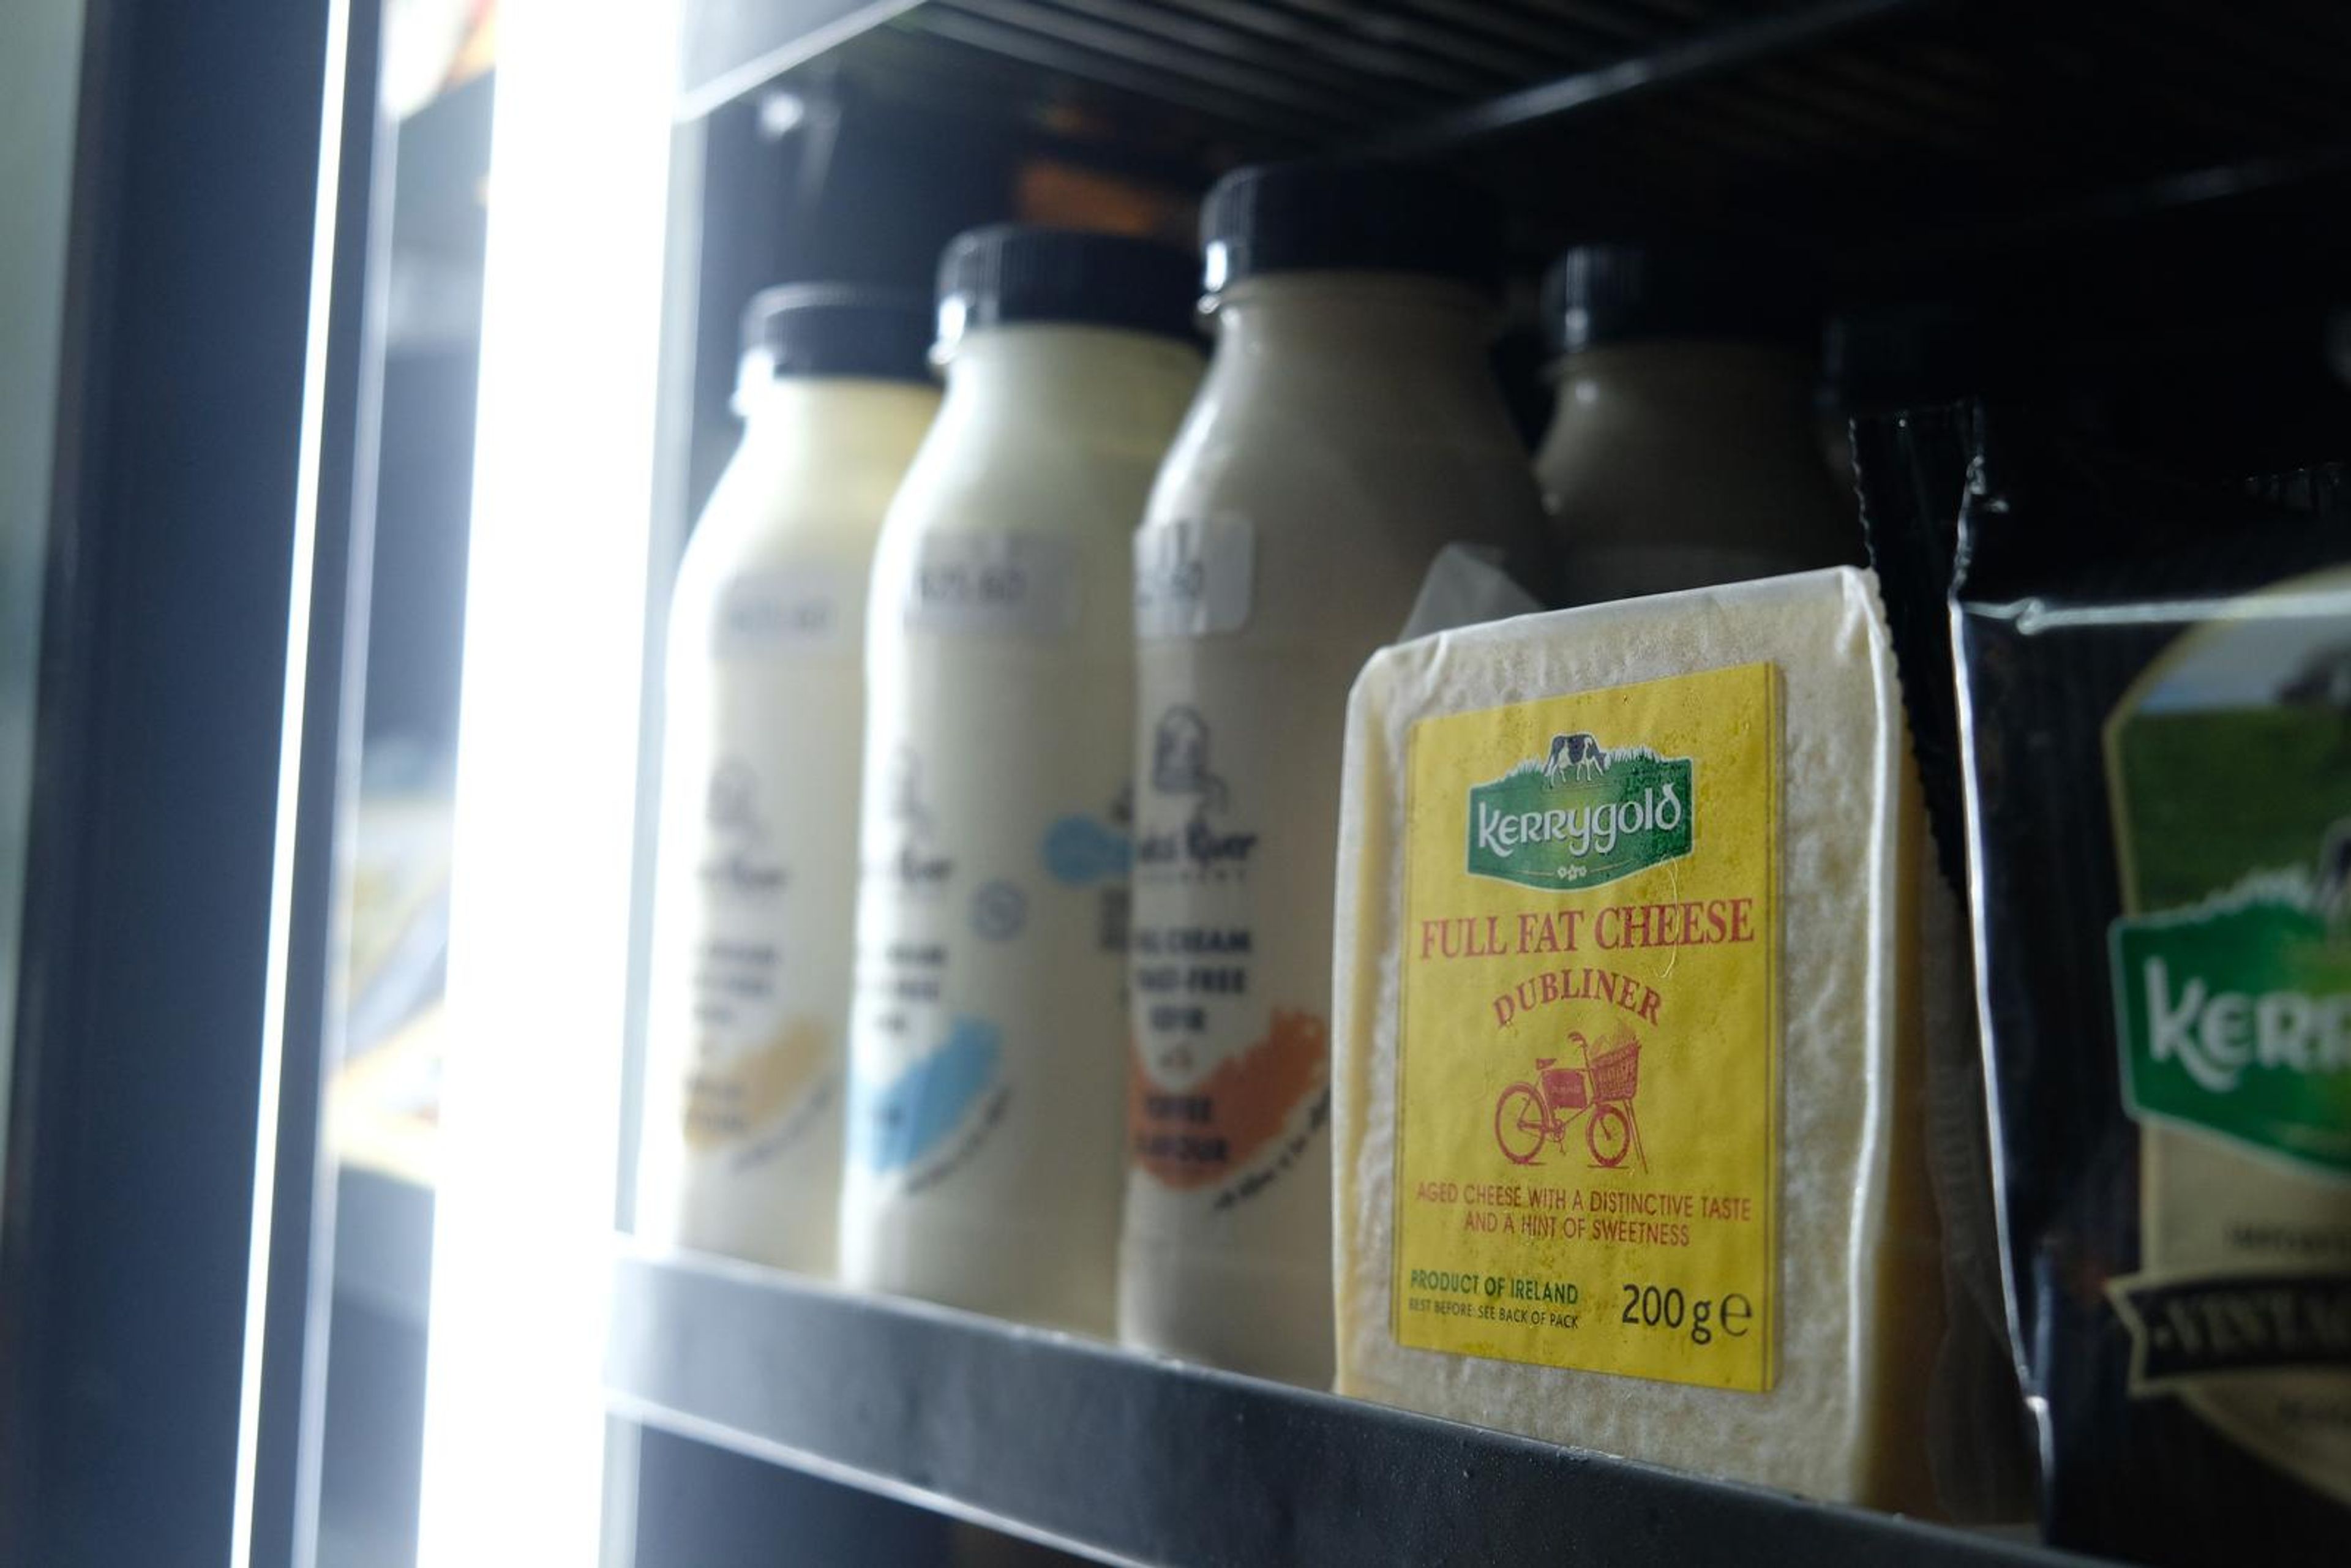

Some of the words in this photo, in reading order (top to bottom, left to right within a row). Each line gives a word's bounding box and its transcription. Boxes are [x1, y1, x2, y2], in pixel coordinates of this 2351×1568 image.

[1419, 915, 1507, 960] FULL
[1516, 910, 1584, 953] FAT
[1594, 898, 1755, 950] CHEESE
[1493, 967, 1663, 1029] DUBLINER
[1417, 1181, 1458, 1204] AGED
[1463, 1184, 1521, 1207] CHEESE
[1528, 1187, 1567, 1212] WITH
[1573, 1189, 1583, 1211] A
[1590, 1190, 1693, 1218] DISTINCTIVE
[1701, 1196, 1752, 1221] TASTE
[1464, 1210, 1498, 1234] AND
[1504, 1213, 1515, 1234] A
[1522, 1215, 1556, 1238] HINT
[1563, 1217, 1586, 1239] OF
[1592, 1218, 1690, 1247] SWEETNESS
[1411, 1269, 1479, 1295] PRODUCT
[1483, 1277, 1505, 1297] OF
[1511, 1277, 1579, 1305] IRELAND
[1409, 1297, 1430, 1311] BEST
[1477, 1305, 1495, 1321] SEE
[1499, 1308, 1528, 1325] BACK
[1531, 1310, 1545, 1326] OF
[1550, 1313, 1578, 1330] PACK
